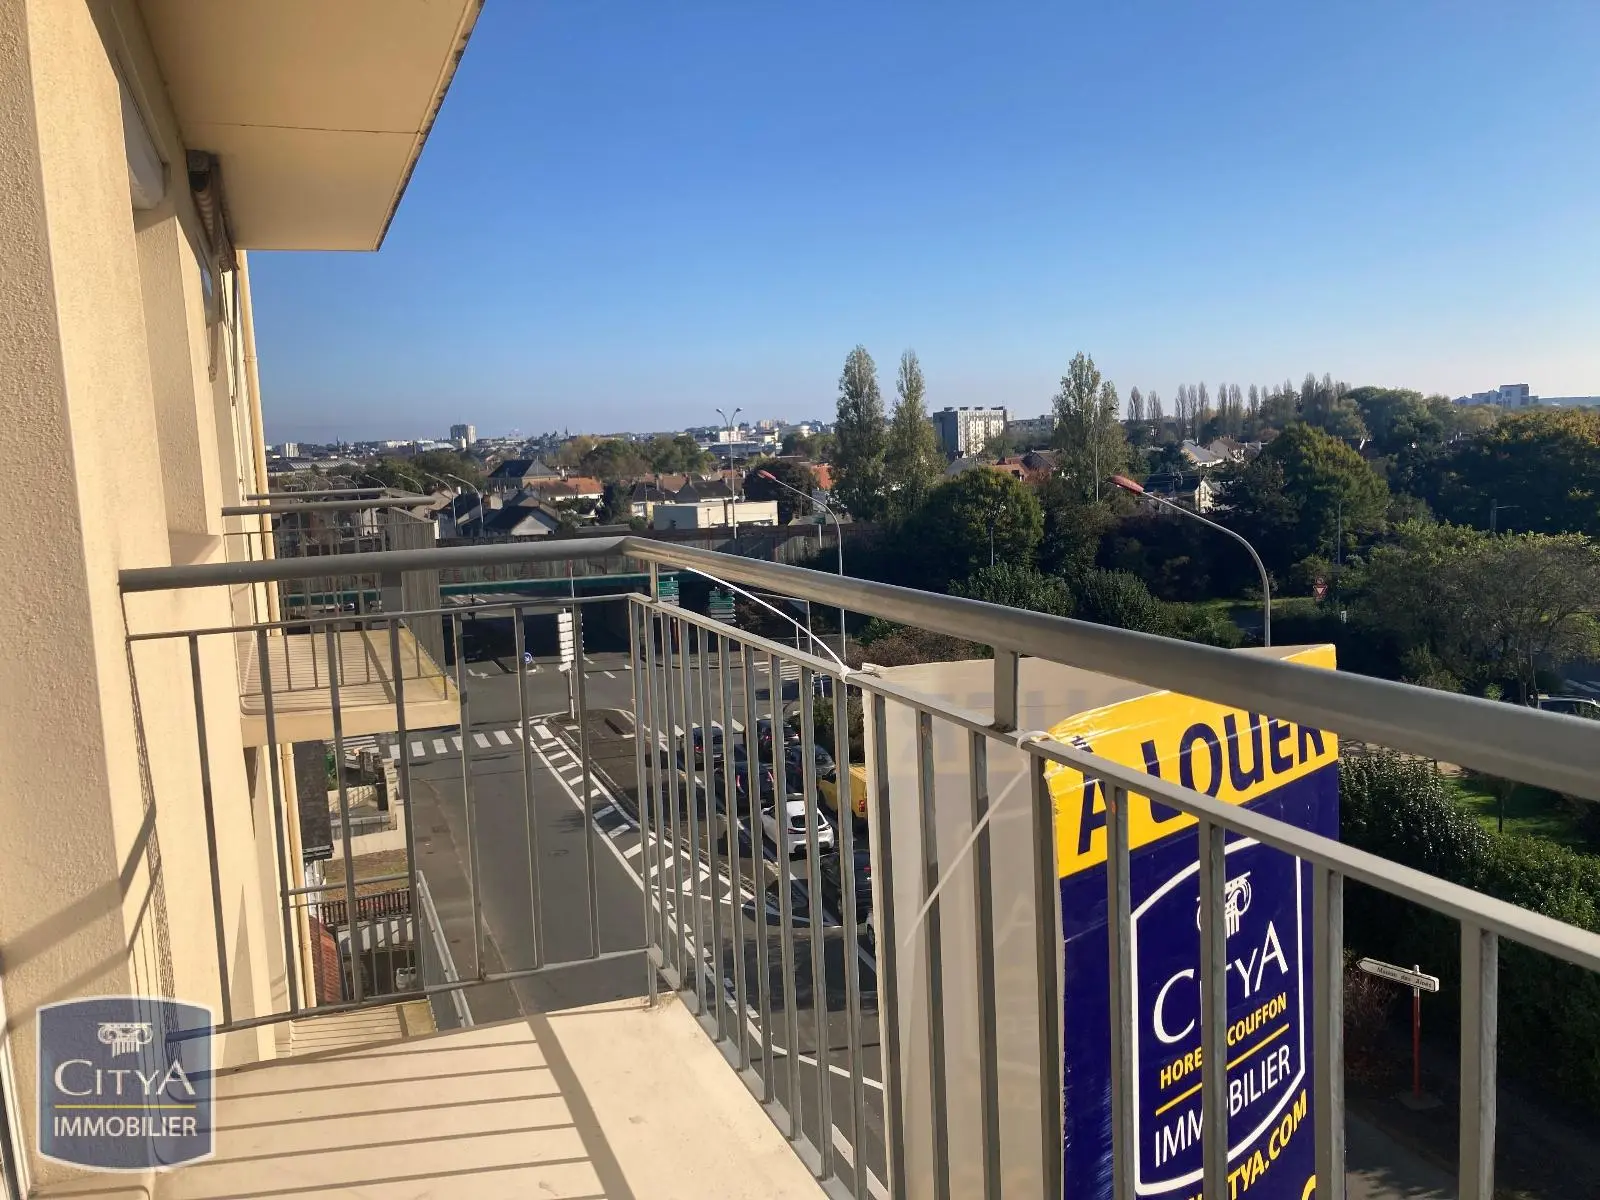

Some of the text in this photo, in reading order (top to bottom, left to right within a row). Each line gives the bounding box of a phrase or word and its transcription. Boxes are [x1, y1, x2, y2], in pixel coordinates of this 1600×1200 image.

[1140, 711, 1326, 824] LOUER
[1153, 920, 1289, 1044] CYA
[1160, 992, 1288, 1090] HORE COUFFON
[1155, 1044, 1291, 1168] IMMBILIER
